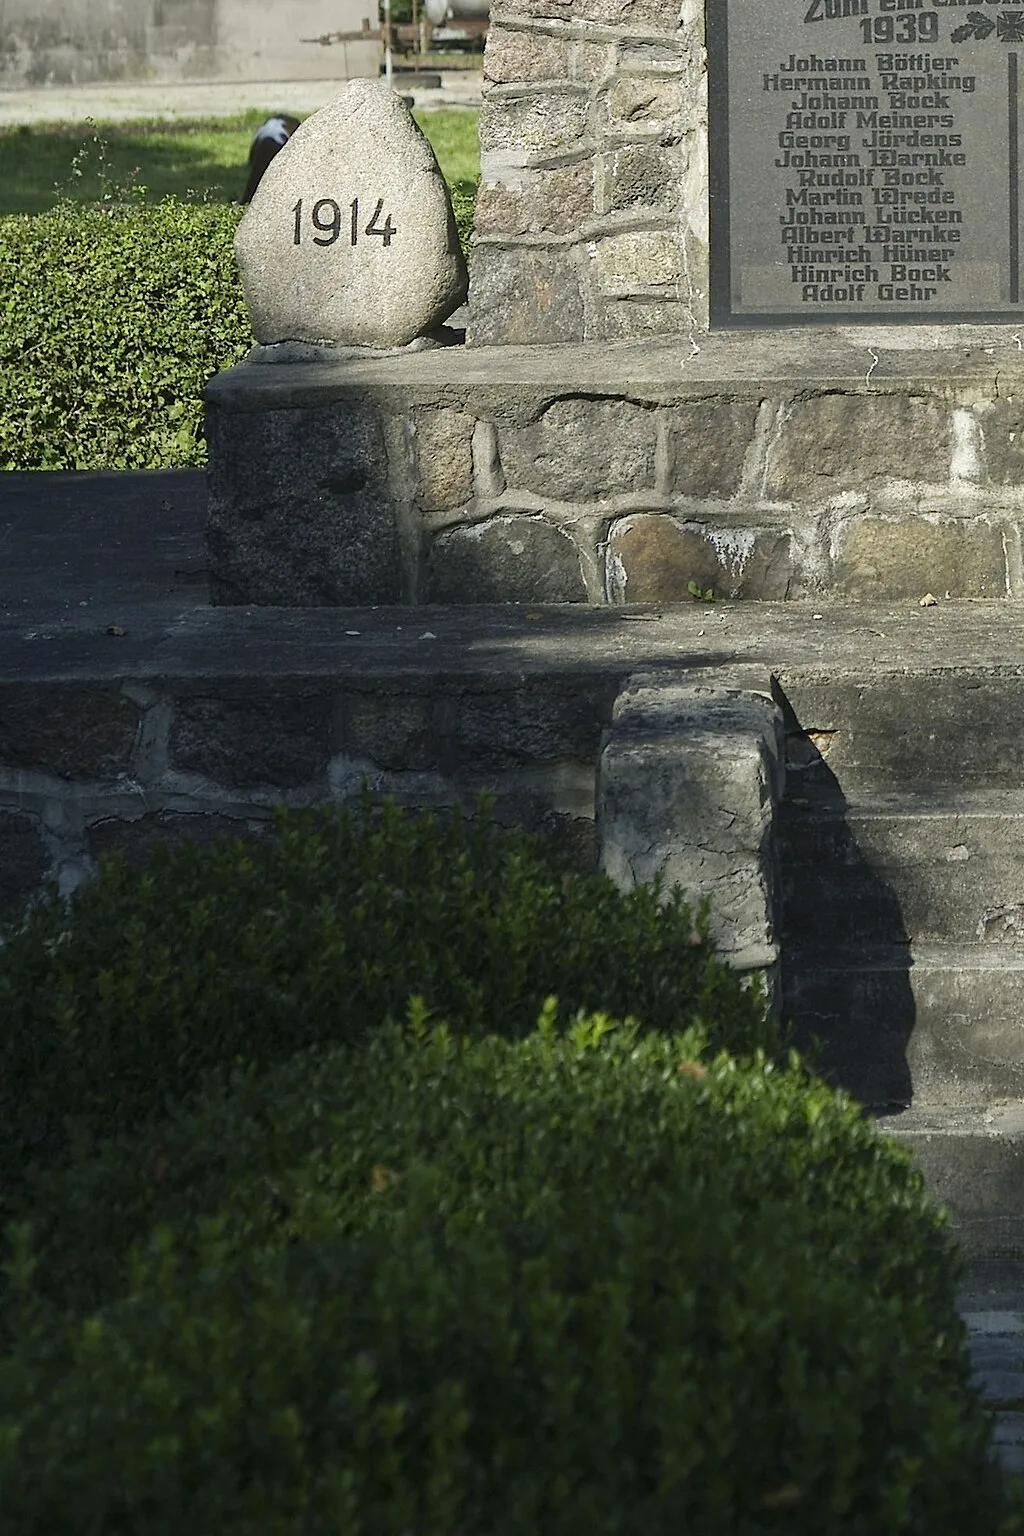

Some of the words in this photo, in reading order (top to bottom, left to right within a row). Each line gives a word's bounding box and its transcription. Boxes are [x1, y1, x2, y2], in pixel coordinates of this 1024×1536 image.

[859, 12, 939, 43] 1939
[780, 55, 866, 72] Johann
[876, 54, 959, 72] Böttjer
[763, 74, 870, 91] Hermann
[880, 73, 975, 92] Rapking
[792, 93, 878, 110] Johann
[888, 92, 949, 109] Bock
[786, 112, 847, 129] Adolf
[856, 112, 953, 128] Meiners
[779, 132, 850, 151] Georg
[862, 131, 962, 147] Jördens
[775, 150, 860, 168] Johann
[869, 150, 966, 166] Warnke
[797, 169, 874, 187] Rudolf
[882, 168, 944, 186] Bock
[785, 189, 862, 206] Martin
[872, 187, 954, 204] Wrede
[292, 198, 396, 246] 1914
[780, 208, 865, 225] Johann
[876, 207, 962, 224] Lücken
[781, 227, 854, 244] Albert
[863, 226, 960, 243] Warnke
[787, 246, 871, 263] Hinrich
[882, 245, 955, 262] Hüner
[792, 265, 878, 282] Hinrich
[891, 265, 952, 282] Bock
[802, 285, 865, 302] Adolf
[878, 285, 937, 301] Gehr
